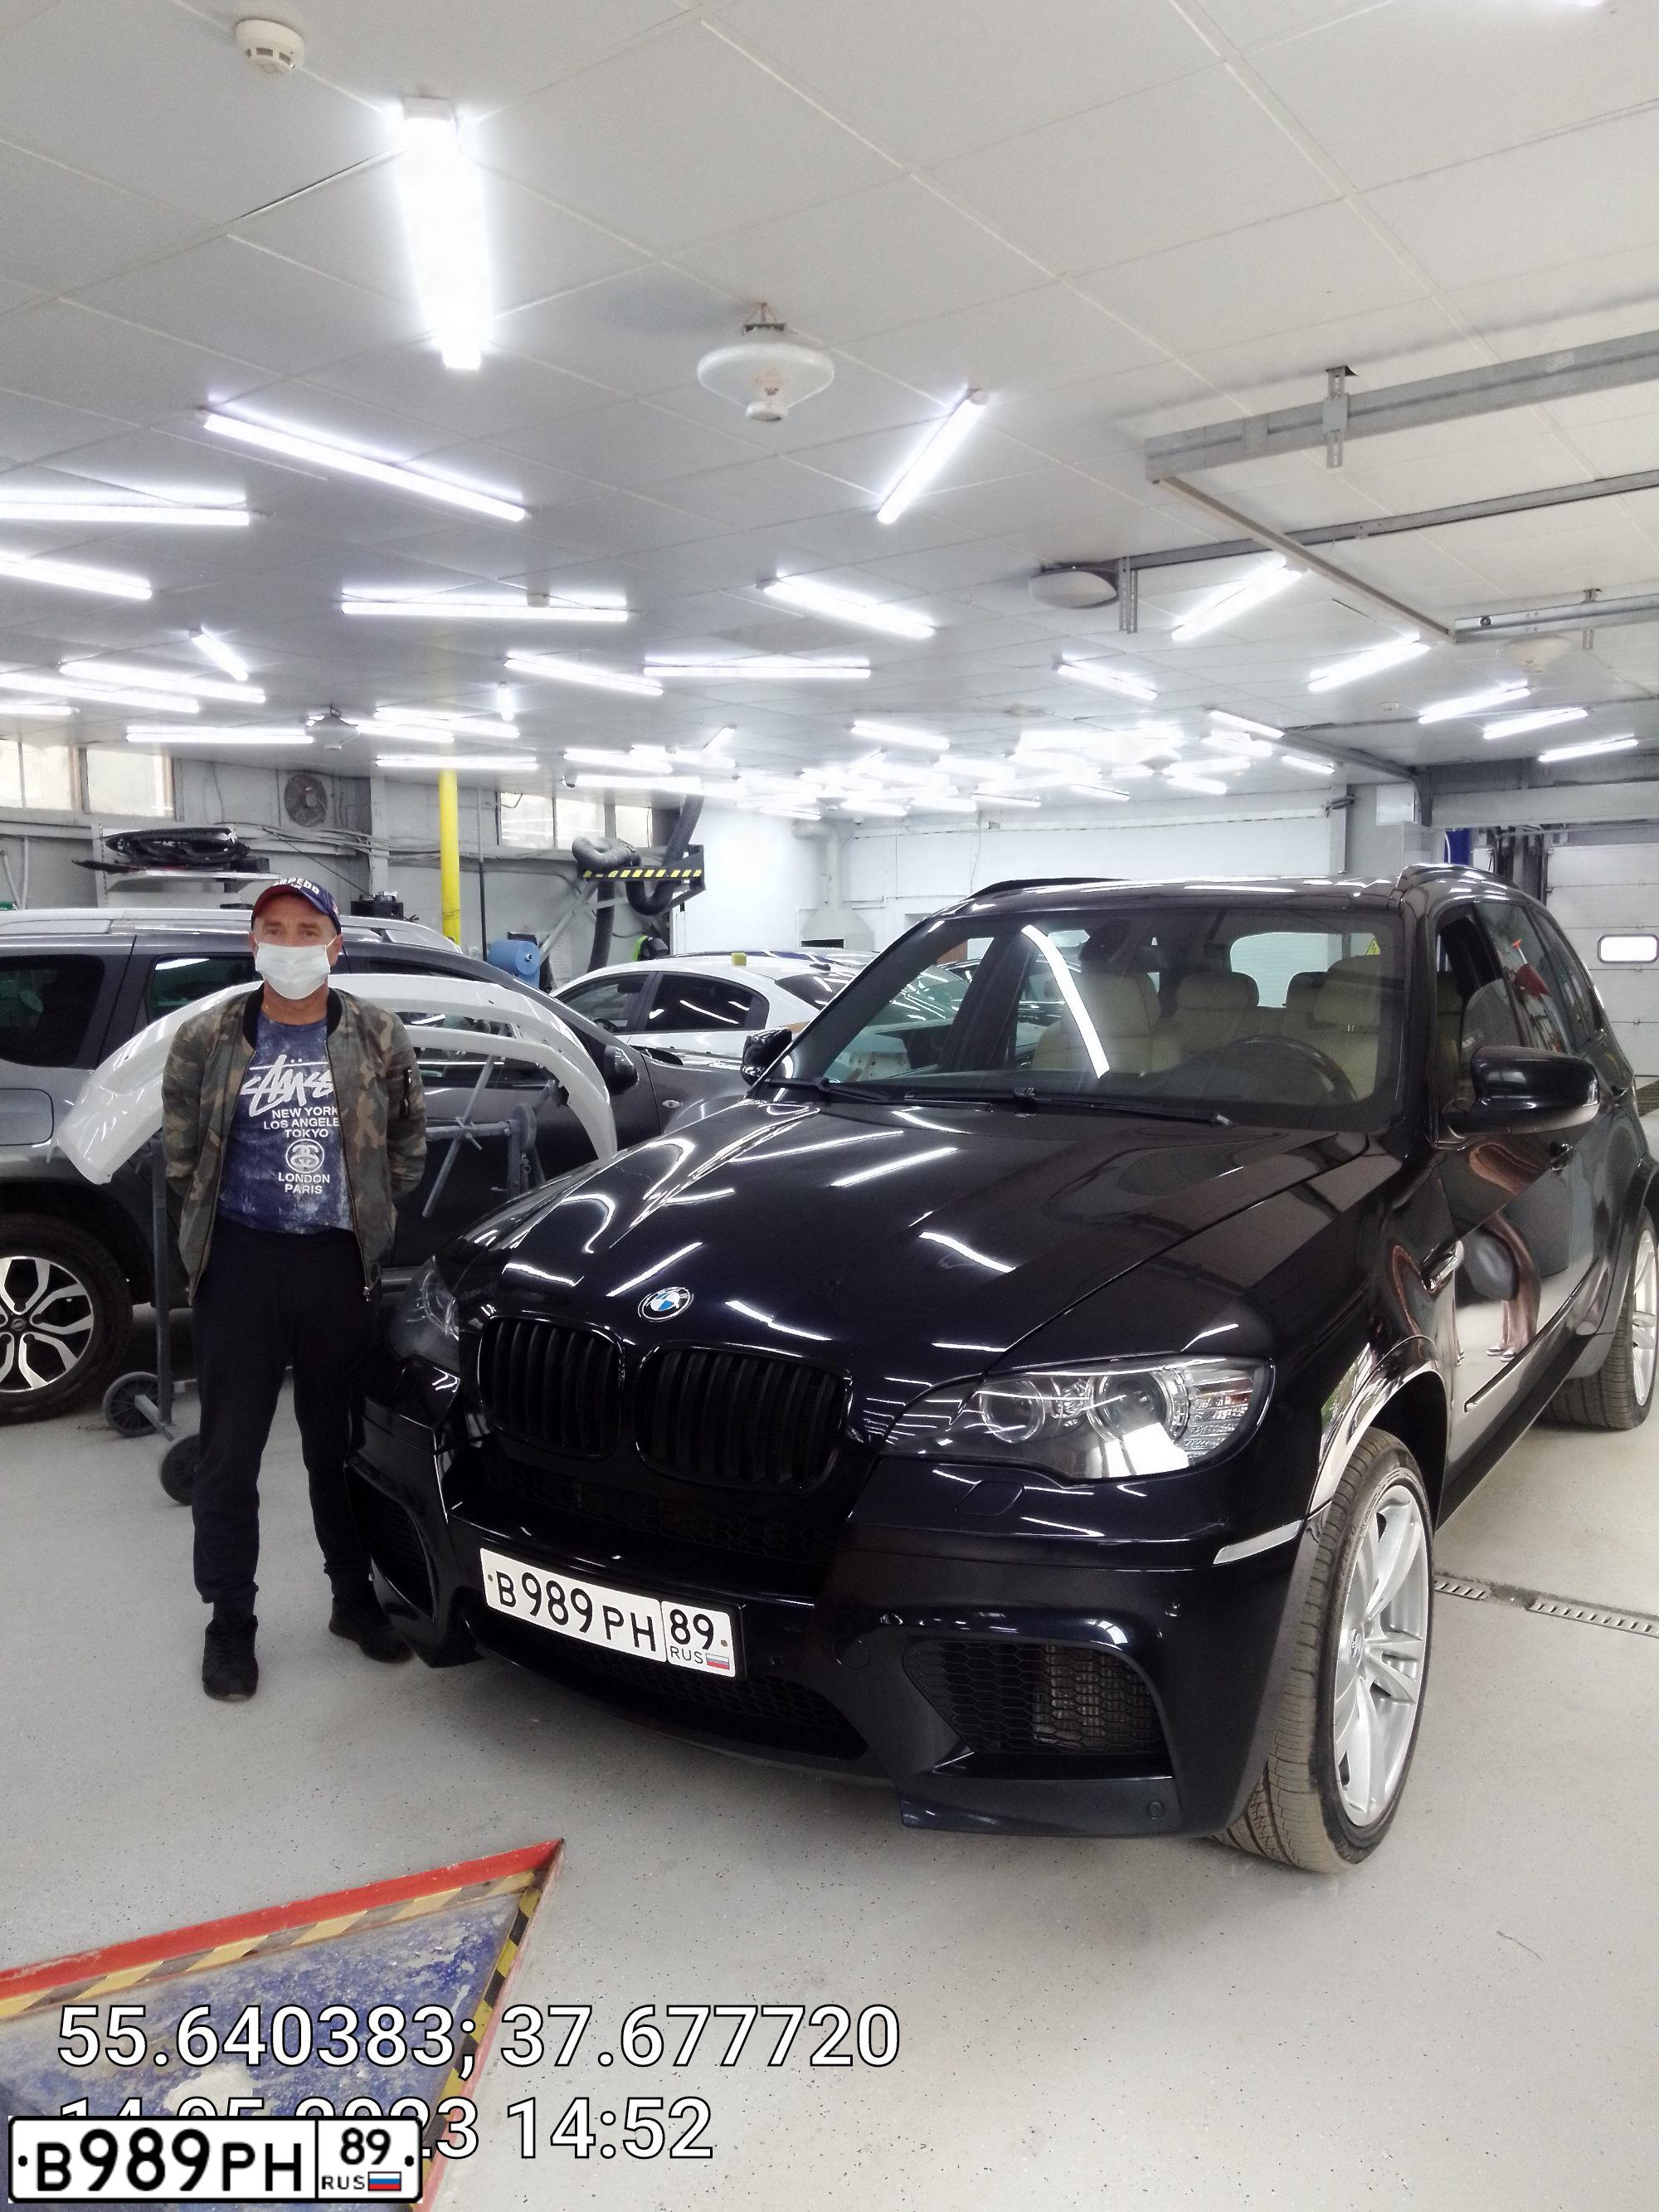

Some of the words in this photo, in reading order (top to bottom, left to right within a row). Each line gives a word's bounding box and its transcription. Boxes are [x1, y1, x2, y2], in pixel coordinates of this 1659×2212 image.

[271, 1108, 301, 1119] NEW
[263, 1119, 289, 1130] LOS
[292, 1117, 340, 1128] ANGELE
[285, 1128, 328, 1138] TOKYO
[278, 1172, 330, 1184] LONDON
[285, 1183, 323, 1194] PARIS
[669, 1609, 714, 1650] 89
[669, 1645, 703, 1664] RUS
